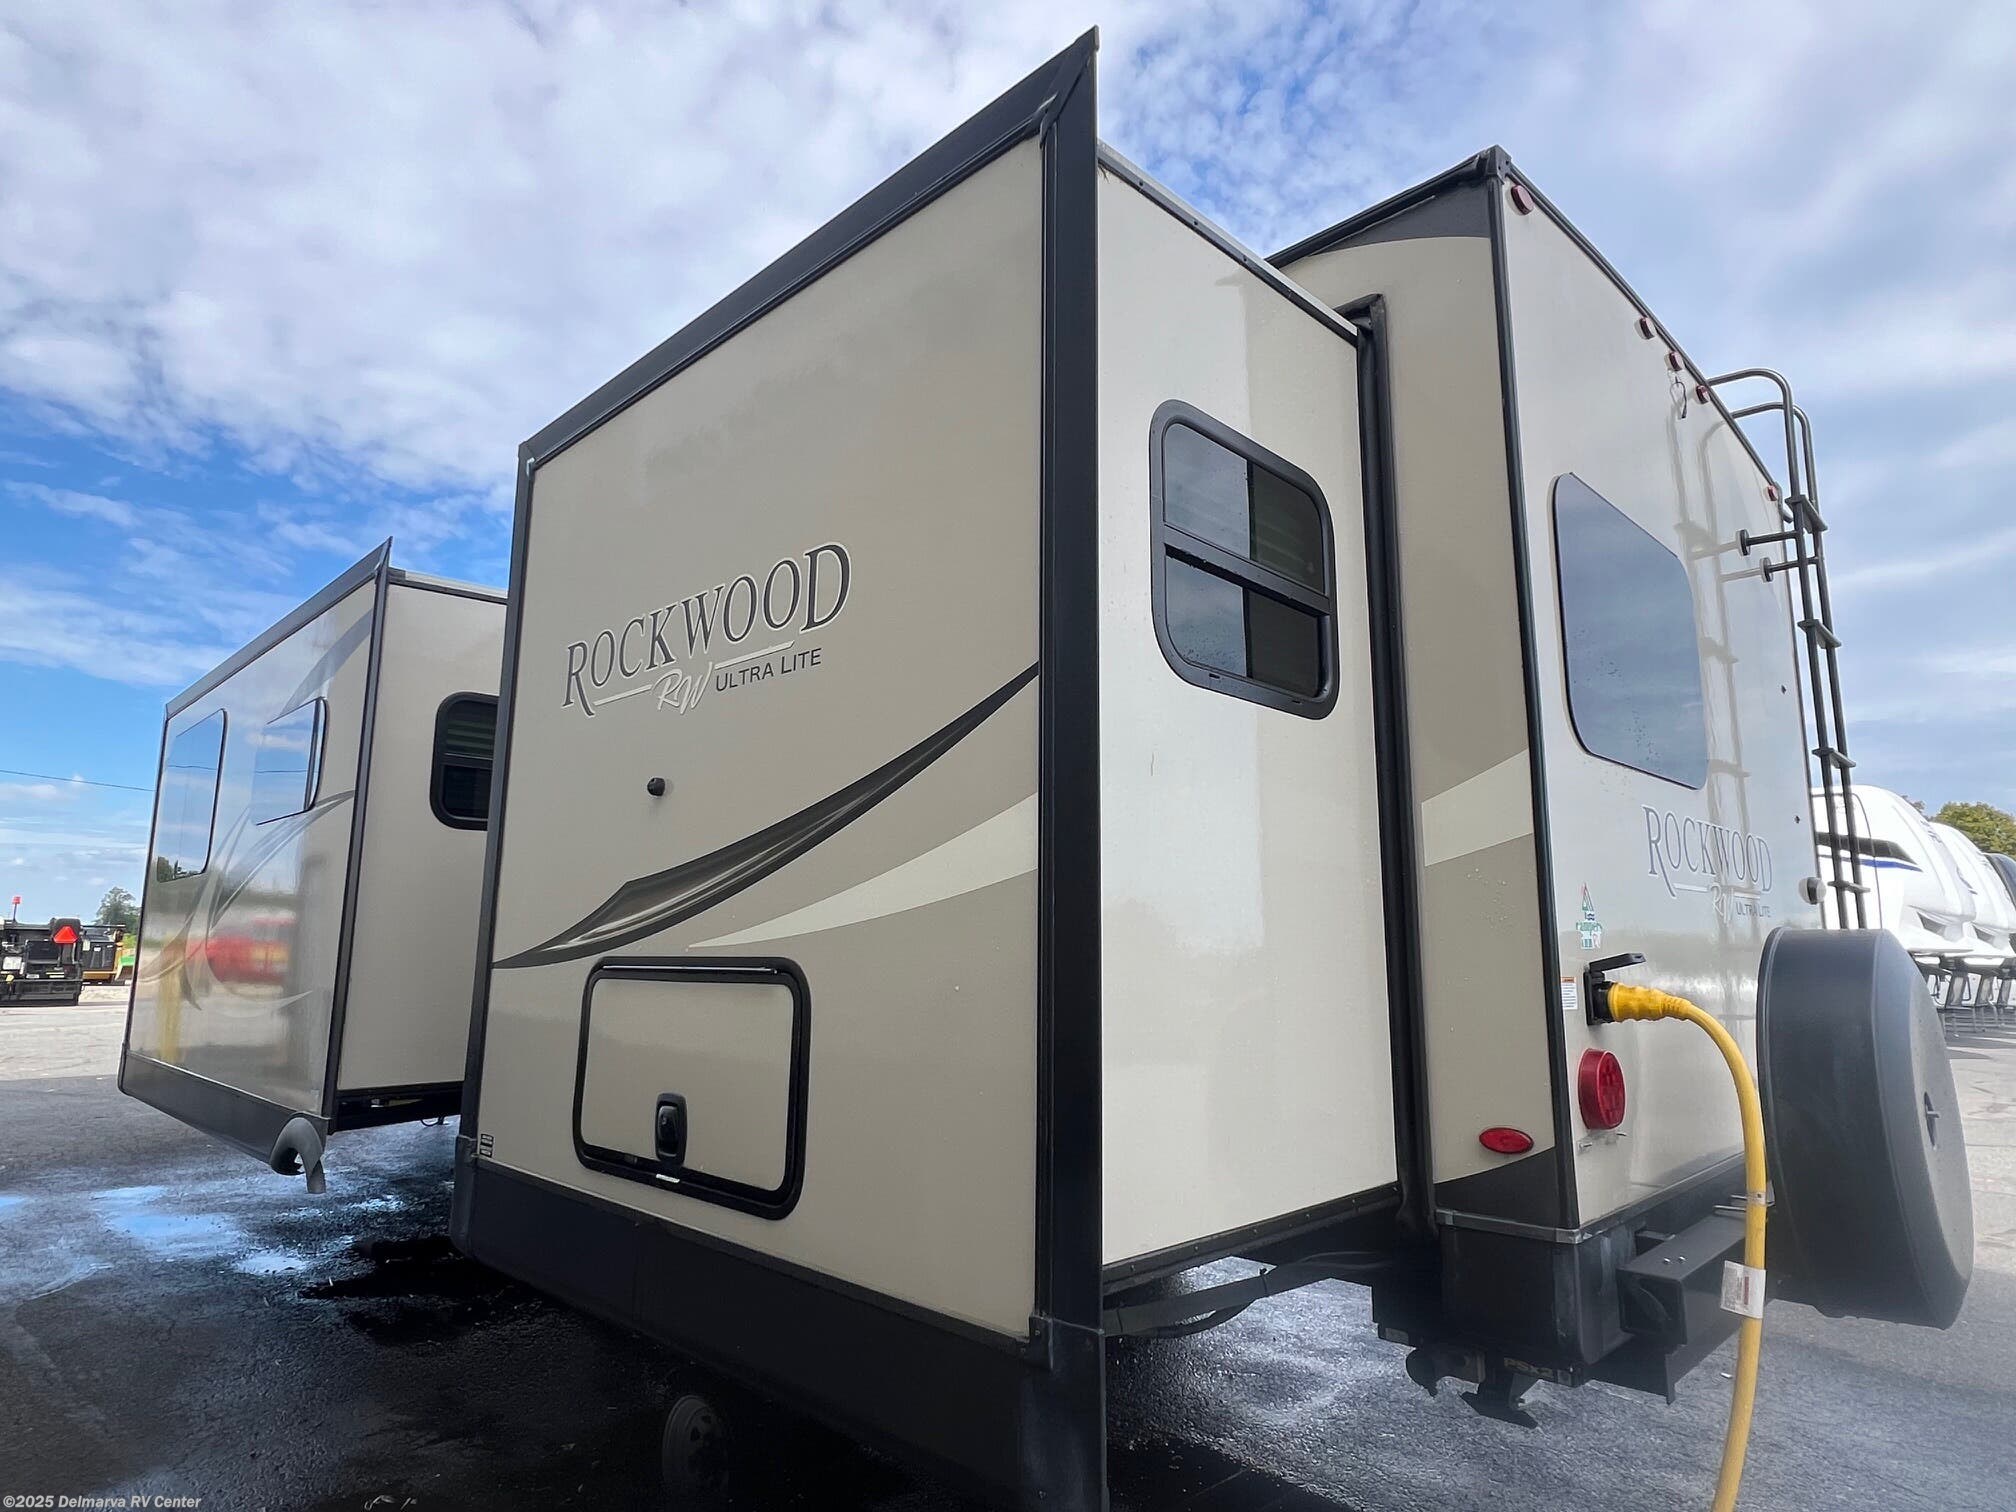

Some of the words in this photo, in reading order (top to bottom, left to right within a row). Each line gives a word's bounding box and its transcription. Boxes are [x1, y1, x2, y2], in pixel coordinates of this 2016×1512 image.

[561, 542, 852, 717] ROCKWOOD
[715, 662, 774, 692] ULTRA
[780, 648, 822, 675] LITE
[1641, 804, 1773, 898] ROCKWOOD
[1735, 901, 1759, 917] ULTRA
